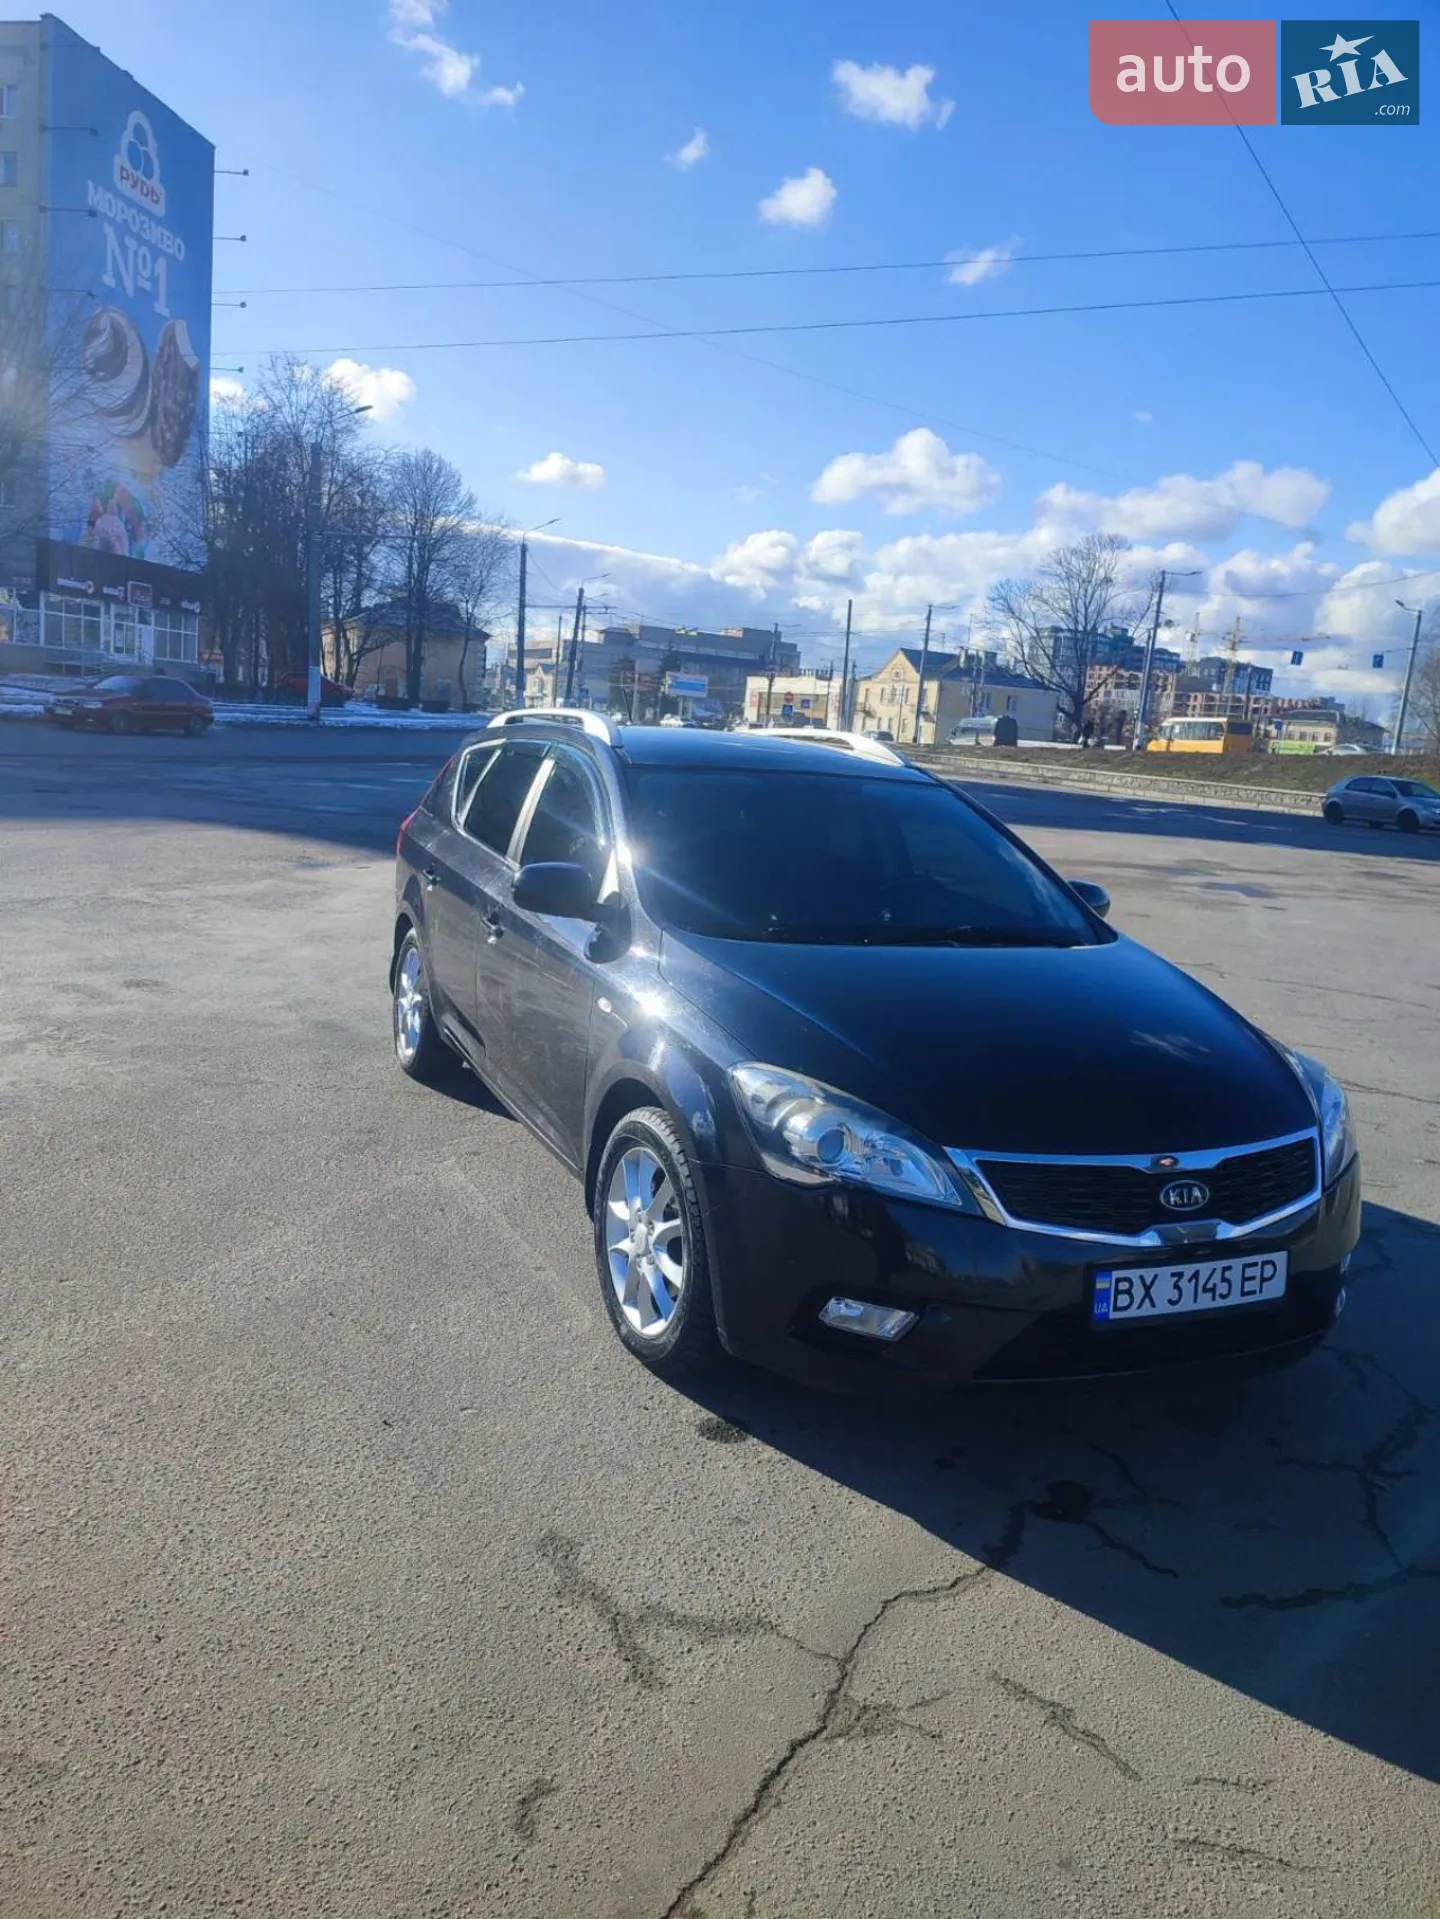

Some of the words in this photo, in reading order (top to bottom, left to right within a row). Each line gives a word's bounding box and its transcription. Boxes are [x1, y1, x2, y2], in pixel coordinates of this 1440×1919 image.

[87, 179, 186, 262] МОРОЗИВО
[1168, 1186, 1204, 1206] KIA
[1112, 1273, 1159, 1313] BX
[1167, 1265, 1233, 1307] 3145
[1240, 1259, 1278, 1298] EP
[1093, 1302, 1109, 1315] UA
